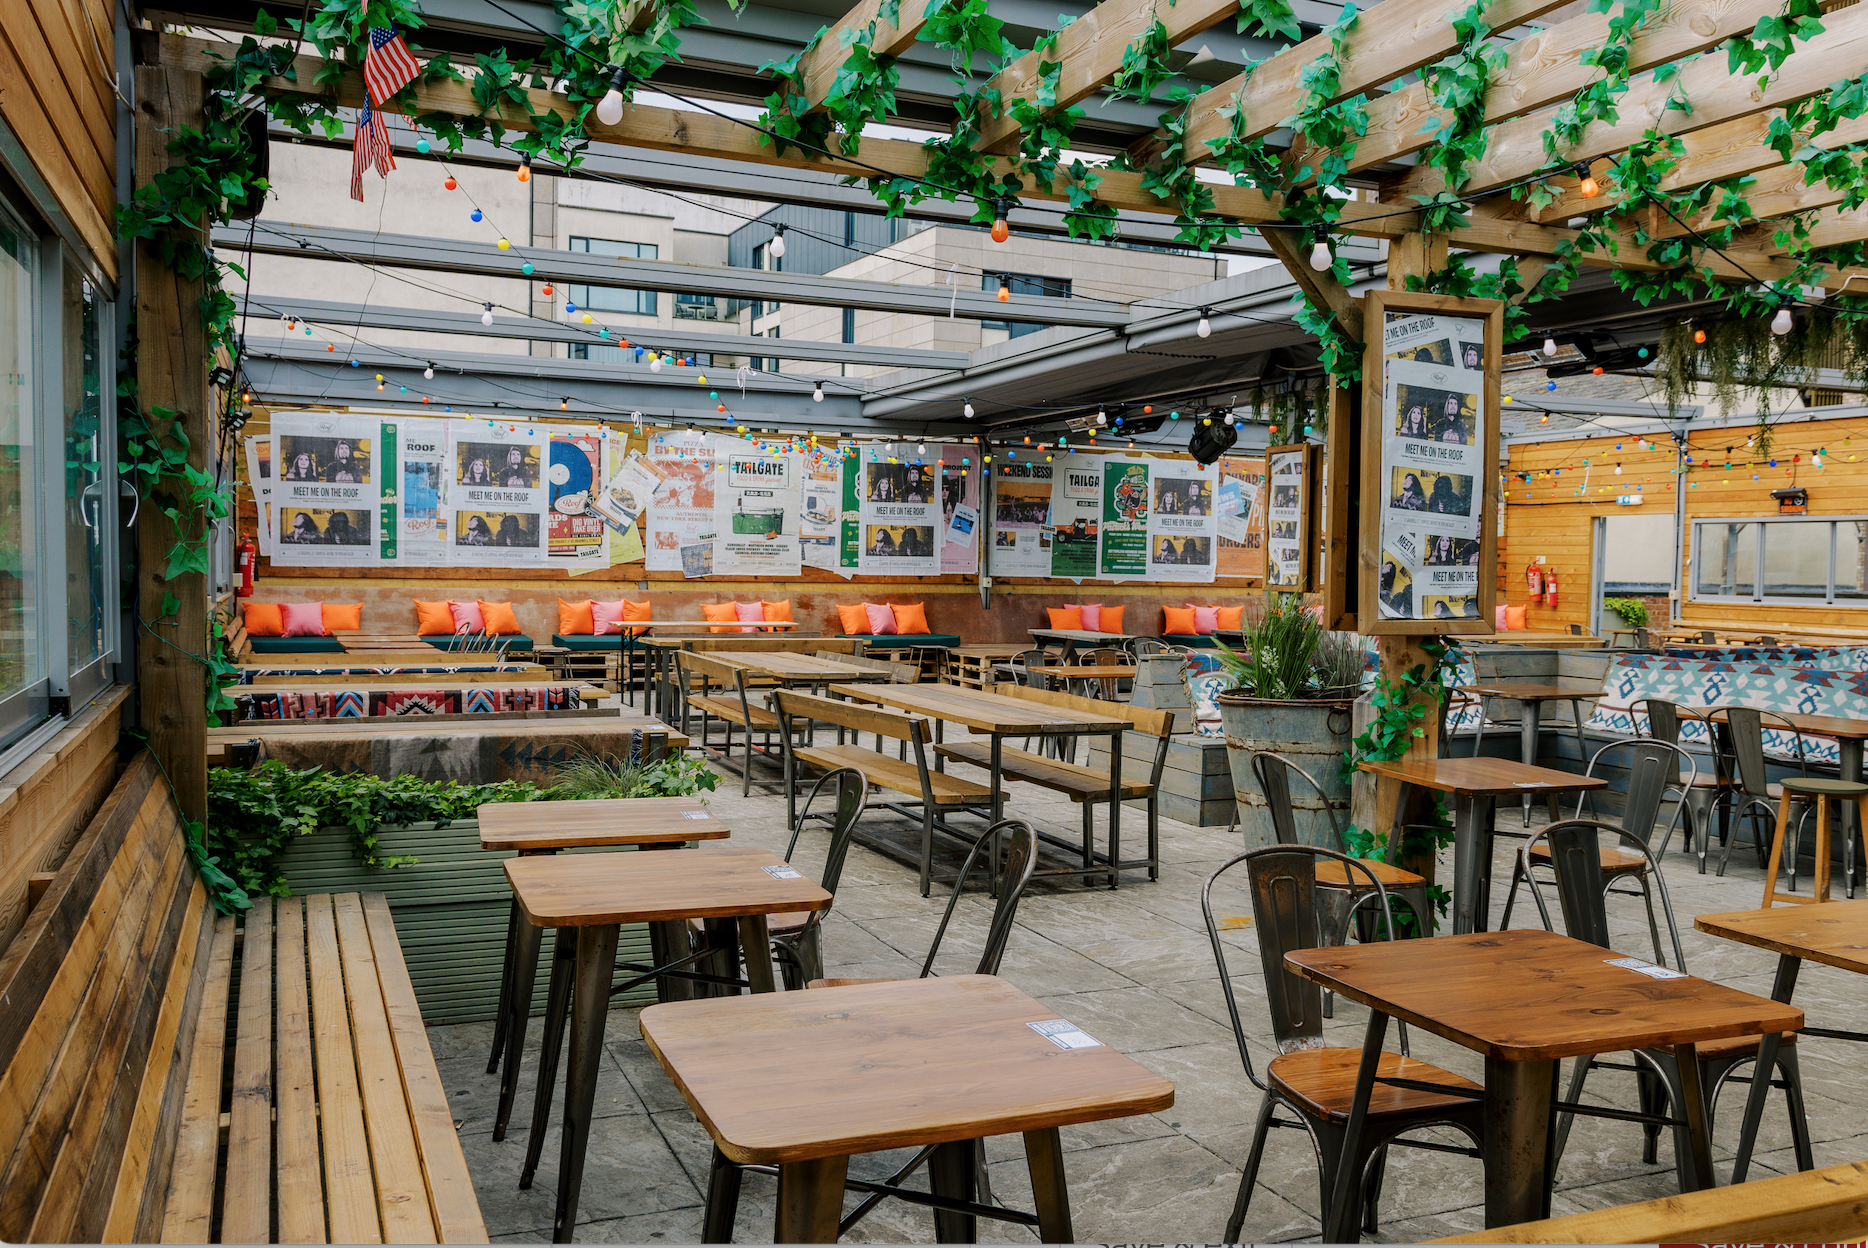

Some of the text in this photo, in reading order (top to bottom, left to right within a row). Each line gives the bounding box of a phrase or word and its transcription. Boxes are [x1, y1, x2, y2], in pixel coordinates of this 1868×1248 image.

[1390, 327, 1399, 339] ME
[1399, 326, 1408, 336] ON
[1408, 322, 1419, 334] THE
[1420, 317, 1434, 330] ROOF
[674, 447, 696, 456] THE
[1405, 443, 1419, 455] MEET
[1420, 445, 1428, 456] ME
[1429, 446, 1436, 457] ON
[1438, 447, 1448, 459] THE
[1448, 449, 1463, 460] ROOF
[735, 462, 783, 475] TAILGATE
[1032, 465, 1053, 479] SESSI
[294, 487, 358, 498] MEET ME ON THE ROOF
[469, 491, 528, 502] MEET ME ON THE ROOF
[876, 506, 888, 515] MEET
[913, 507, 925, 516] ROOF
[1397, 534, 1413, 551] MEET
[1433, 572, 1474, 582] MEET ME ON THE
